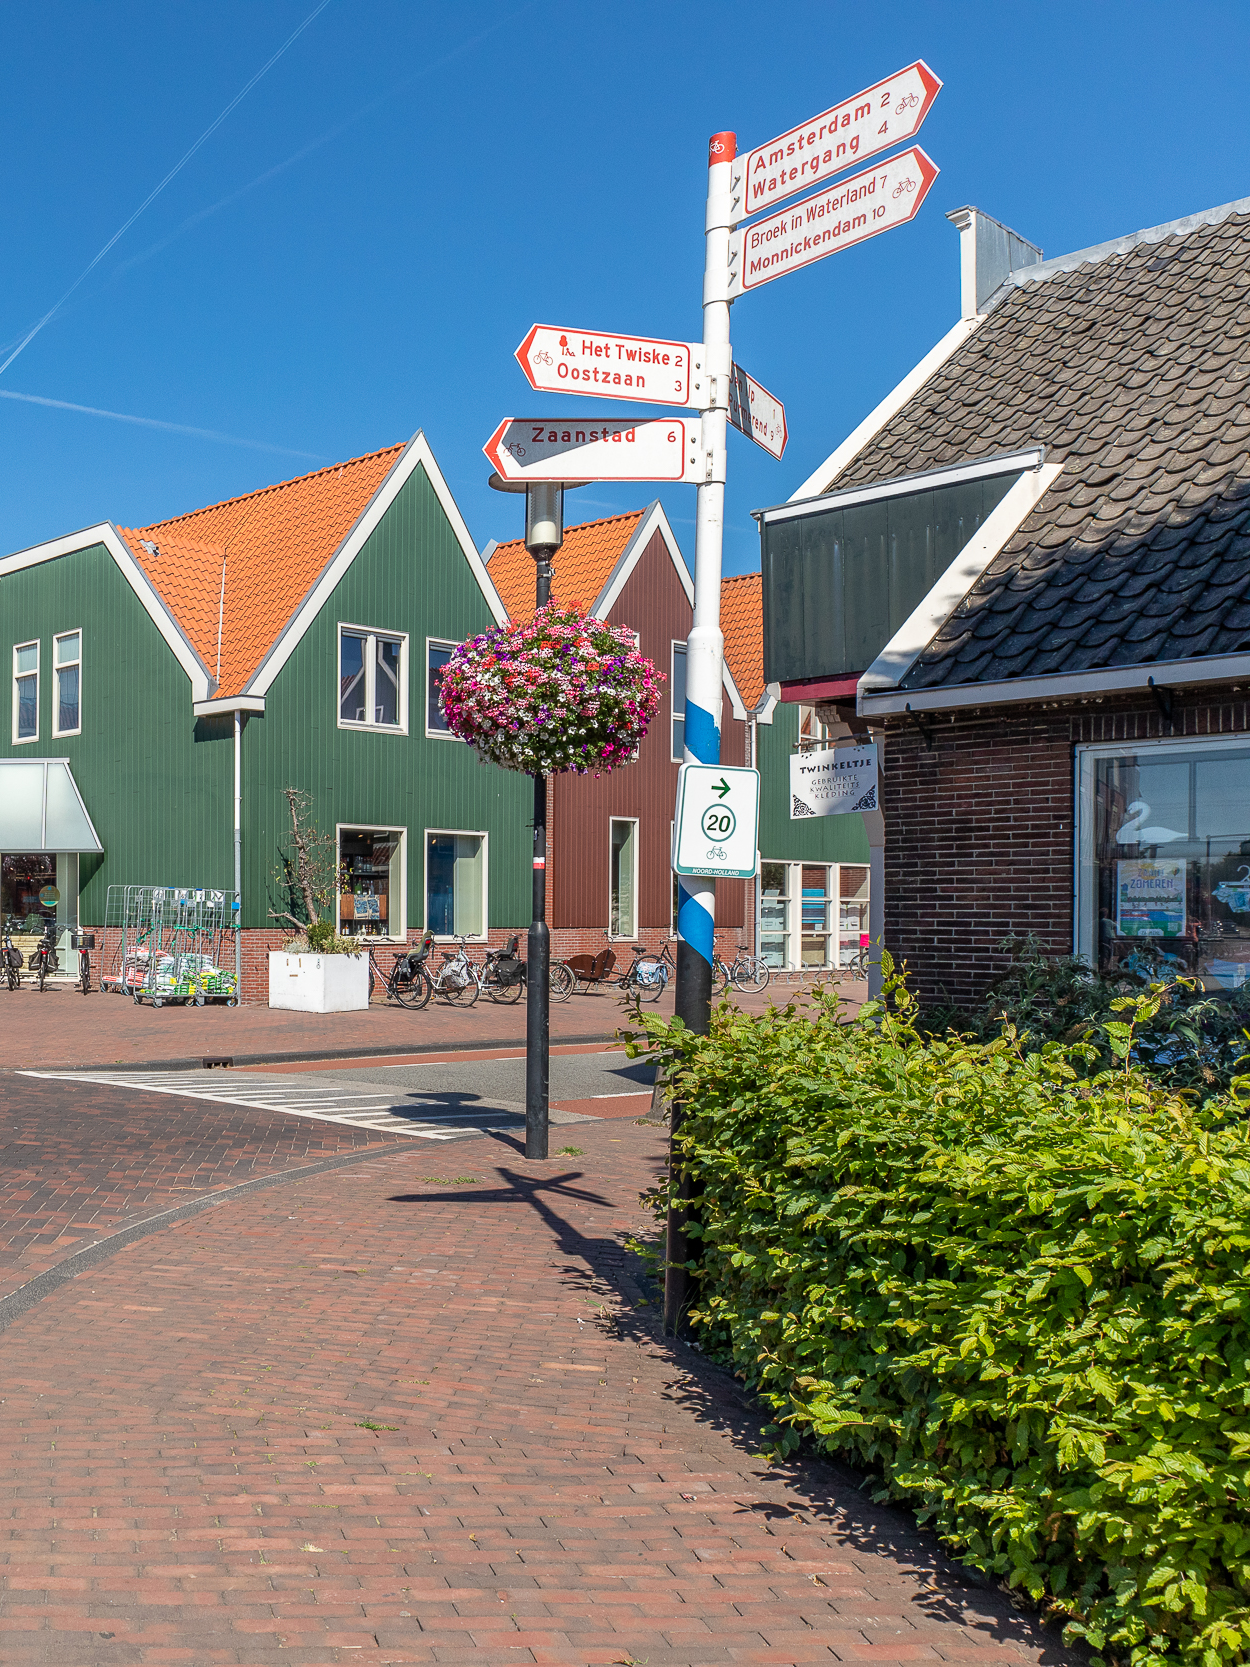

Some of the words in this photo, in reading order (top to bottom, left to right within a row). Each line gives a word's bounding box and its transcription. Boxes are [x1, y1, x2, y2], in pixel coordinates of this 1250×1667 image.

[753, 101, 871, 175] Amsterdam
[880, 92, 891, 109] 2
[752, 134, 860, 199] Watergang
[877, 120, 889, 135] 4
[751, 221, 788, 249] Broek
[790, 213, 803, 231] in
[806, 176, 876, 223] Waterland
[880, 175, 888, 189] 7
[750, 213, 867, 274] Monnickendam
[872, 204, 886, 220] 10
[581, 339, 611, 359] Het
[614, 344, 671, 366] Twiske
[674, 355, 684, 367] 2
[556, 362, 646, 388] Oostzaan
[674, 380, 683, 392] 3
[531, 426, 636, 443] Zaanstad
[667, 431, 677, 443] 6
[799, 758, 872, 774] TWINKELTJE
[809, 781, 860, 793] KWALITEITS
[811, 774, 857, 785] GEBRUIKTE
[814, 789, 855, 799] KLEDING
[706, 814, 731, 833] 20
[691, 867, 740, 876] NOORD-HOLLAND
[1130, 878, 1174, 889] ZOMEREN
